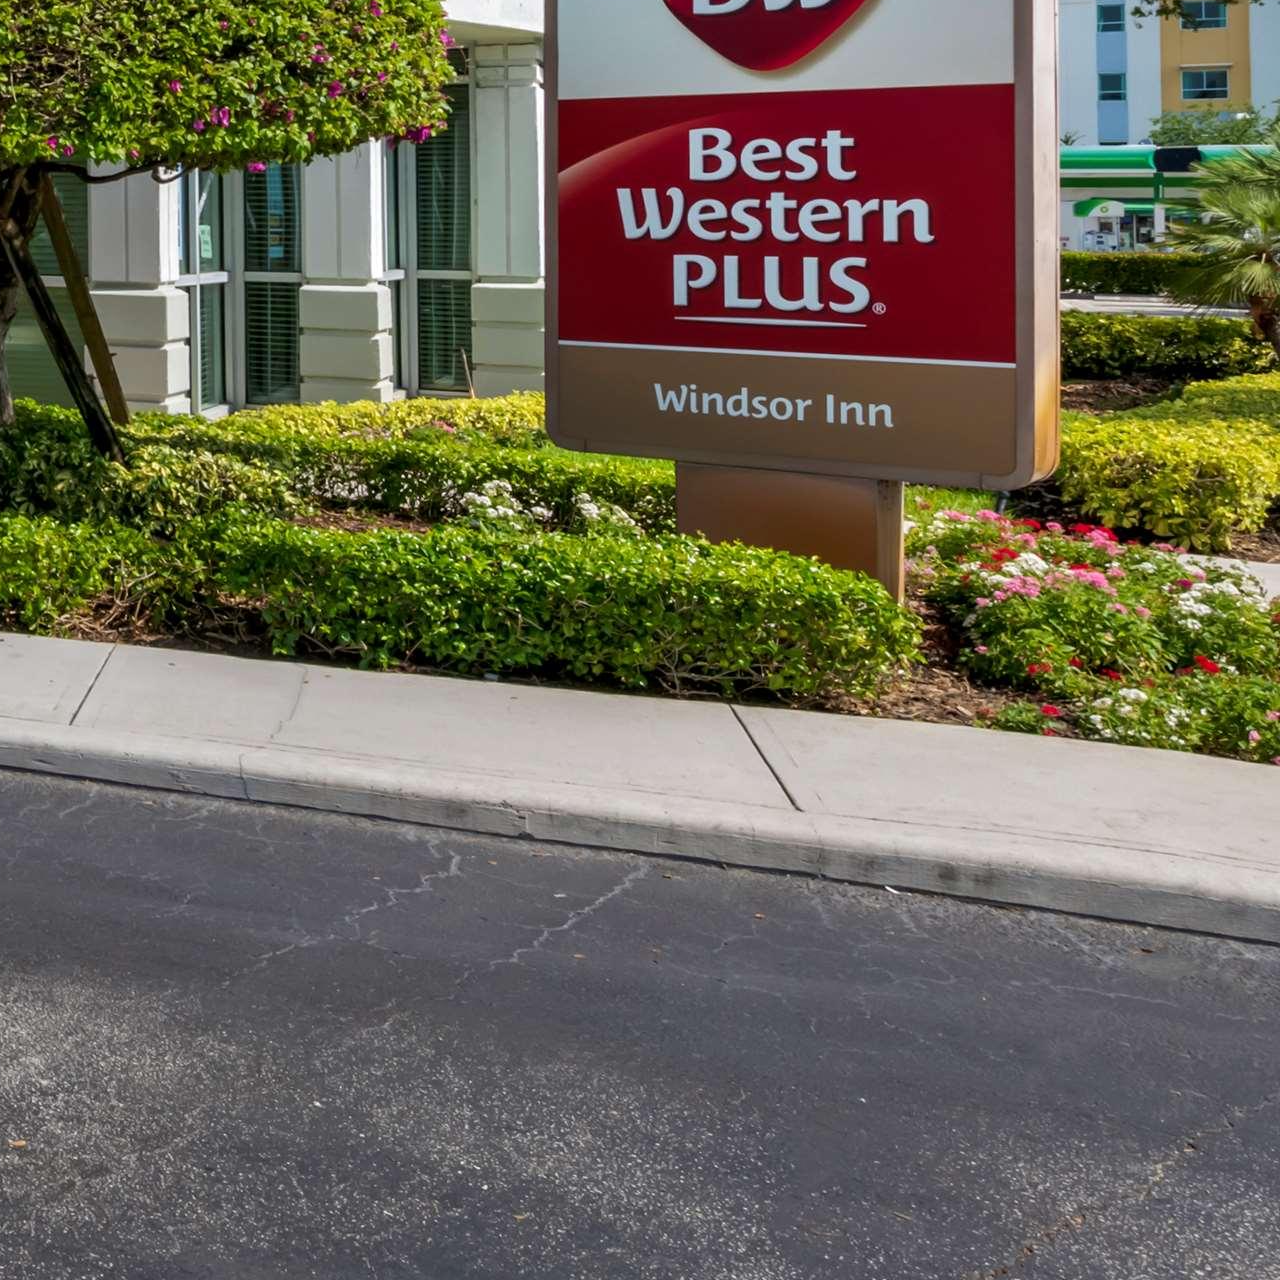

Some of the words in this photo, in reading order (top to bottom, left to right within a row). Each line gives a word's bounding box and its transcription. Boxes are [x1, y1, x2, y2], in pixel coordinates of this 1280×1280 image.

[688, 127, 857, 182] Best
[616, 186, 935, 243] Western
[654, 383, 813, 421] Windsor
[826, 394, 894, 427] Inn
